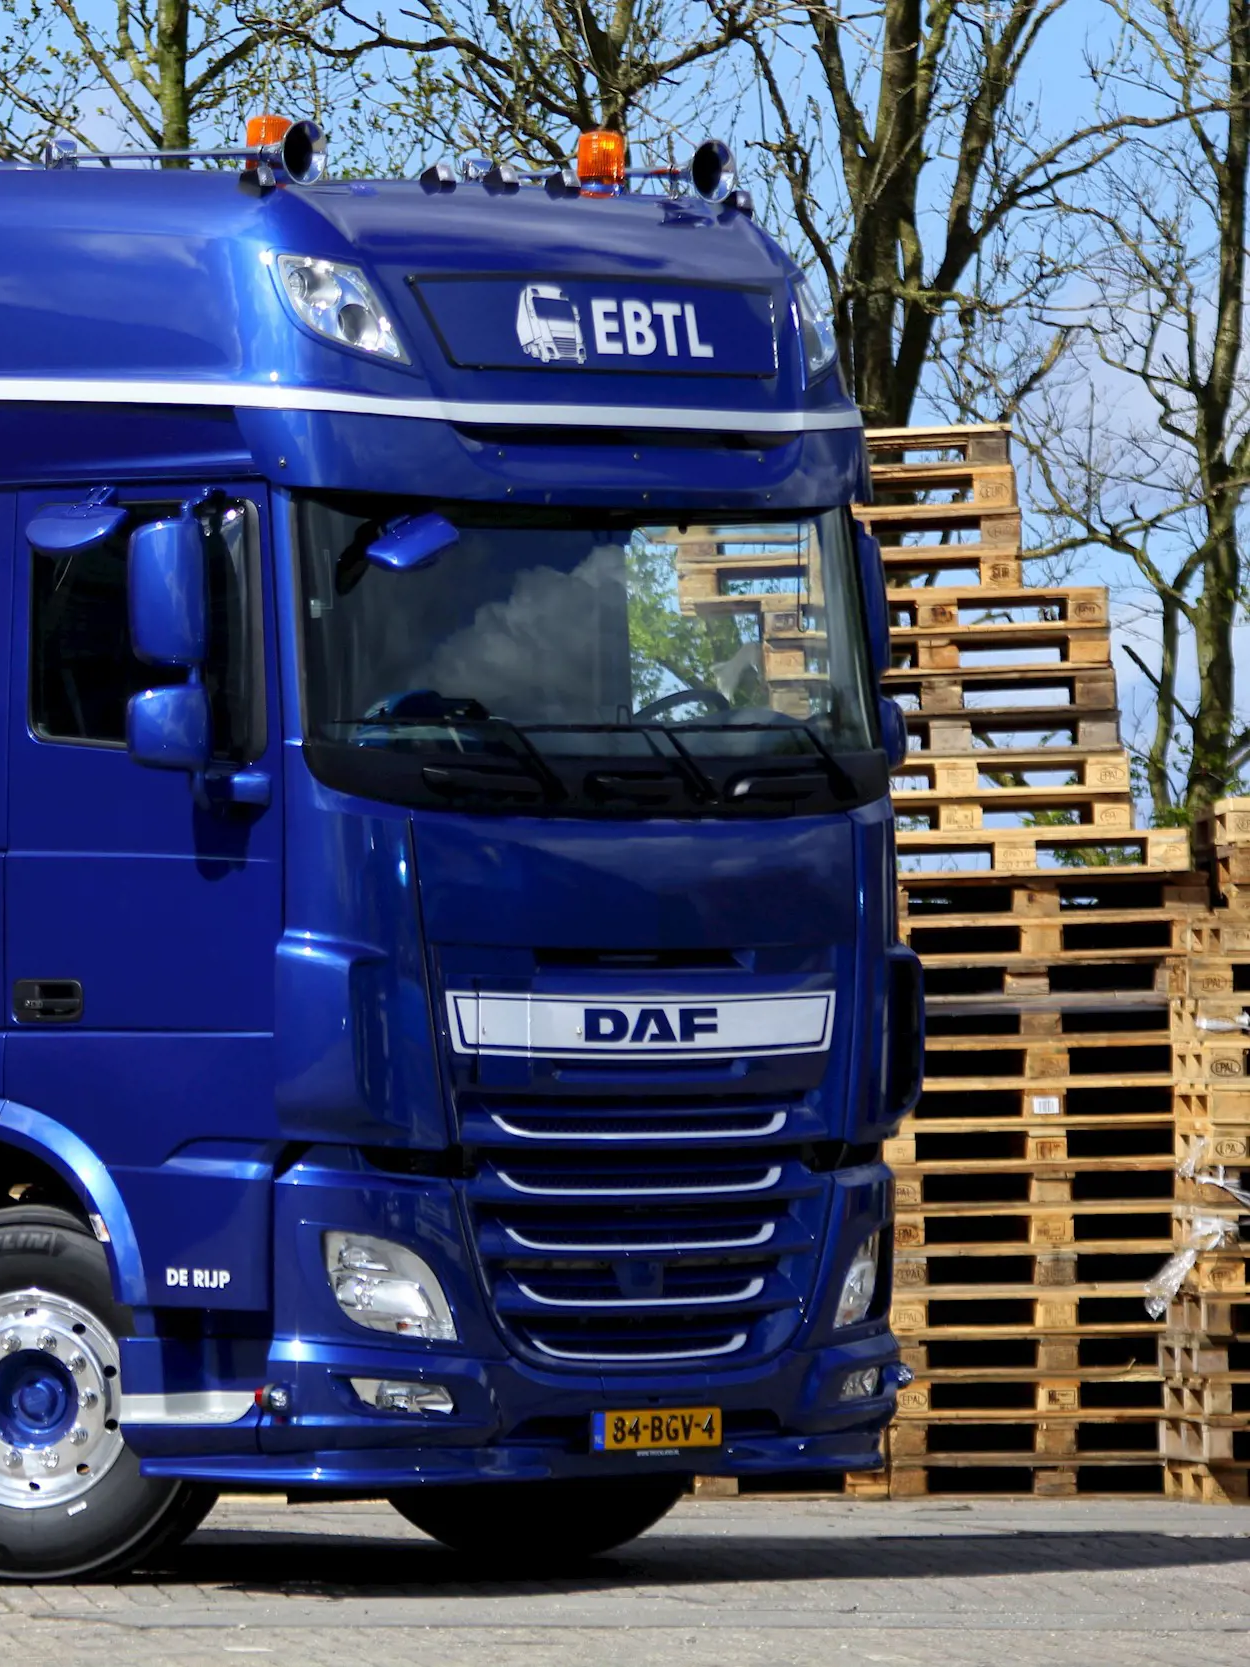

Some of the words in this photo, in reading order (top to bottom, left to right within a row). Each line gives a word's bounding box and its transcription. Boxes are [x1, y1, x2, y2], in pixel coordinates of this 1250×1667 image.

[591, 298, 714, 358] EBTL
[584, 1008, 718, 1043] DAF
[1216, 1062, 1236, 1073] EPAL
[166, 1268, 189, 1287] DE
[193, 1269, 231, 1289] RIJP
[902, 1394, 924, 1406] EPAL
[613, 1413, 715, 1444] 84-BGV-4
